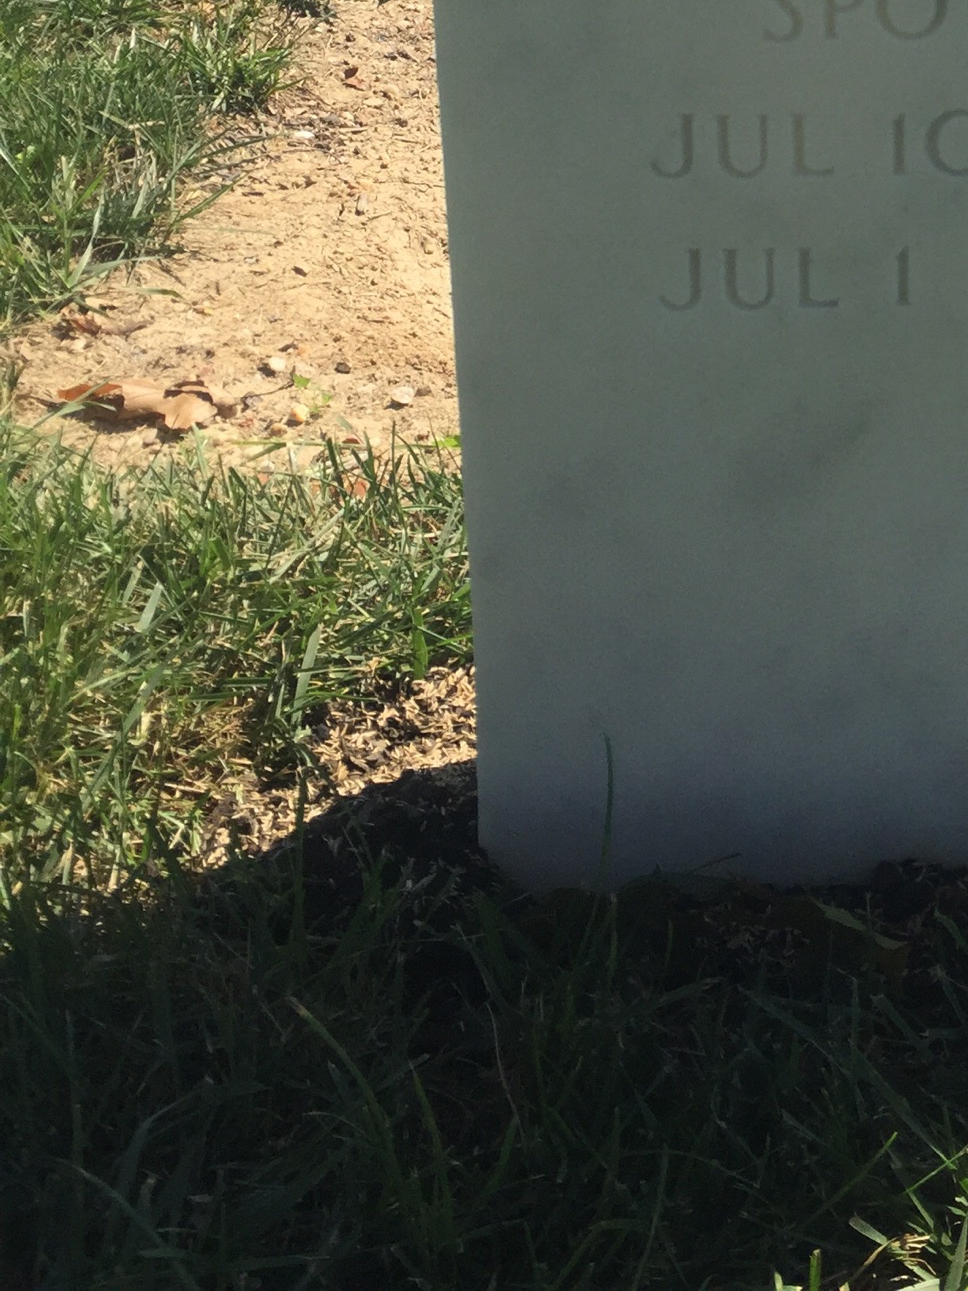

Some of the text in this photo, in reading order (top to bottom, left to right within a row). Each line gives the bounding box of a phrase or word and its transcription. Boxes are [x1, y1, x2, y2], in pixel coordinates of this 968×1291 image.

[650, 112, 836, 179] JUL
[659, 246, 840, 310] JUL
[895, 245, 911, 307] 1
